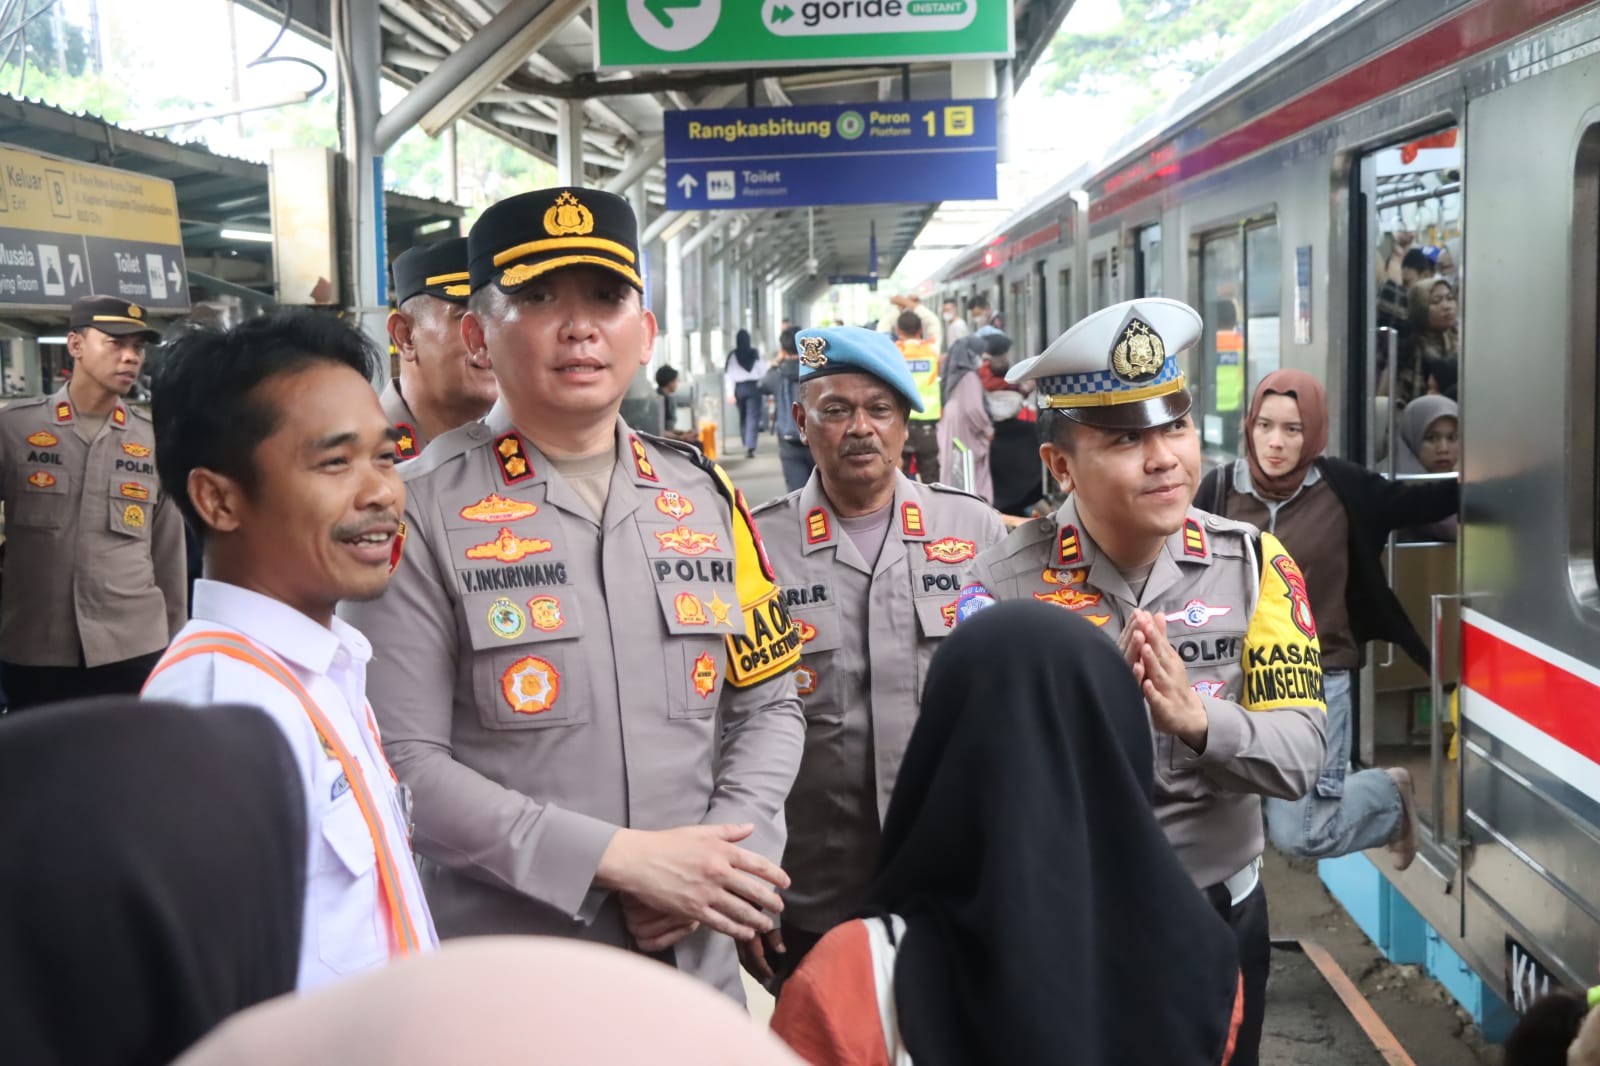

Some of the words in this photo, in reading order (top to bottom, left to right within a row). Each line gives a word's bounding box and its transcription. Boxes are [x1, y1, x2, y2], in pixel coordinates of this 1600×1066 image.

[802, 0, 901, 27] goride
[912, 2, 963, 14] INSTANT
[688, 118, 831, 142] Rangkasbitung
[869, 111, 910, 125] Peron
[922, 111, 936, 137] 1
[6, 165, 43, 190] Keluar
[742, 170, 781, 184] Toilet
[53, 181, 64, 205] B
[114, 252, 141, 273] Toilet
[27, 450, 63, 466] AGIL
[115, 458, 154, 475] POLRI
[461, 562, 568, 593] V.INKIRIWANG
[654, 559, 734, 583] POLRI
[741, 648, 770, 672] OPS
[1169, 638, 1236, 664] OLRI
